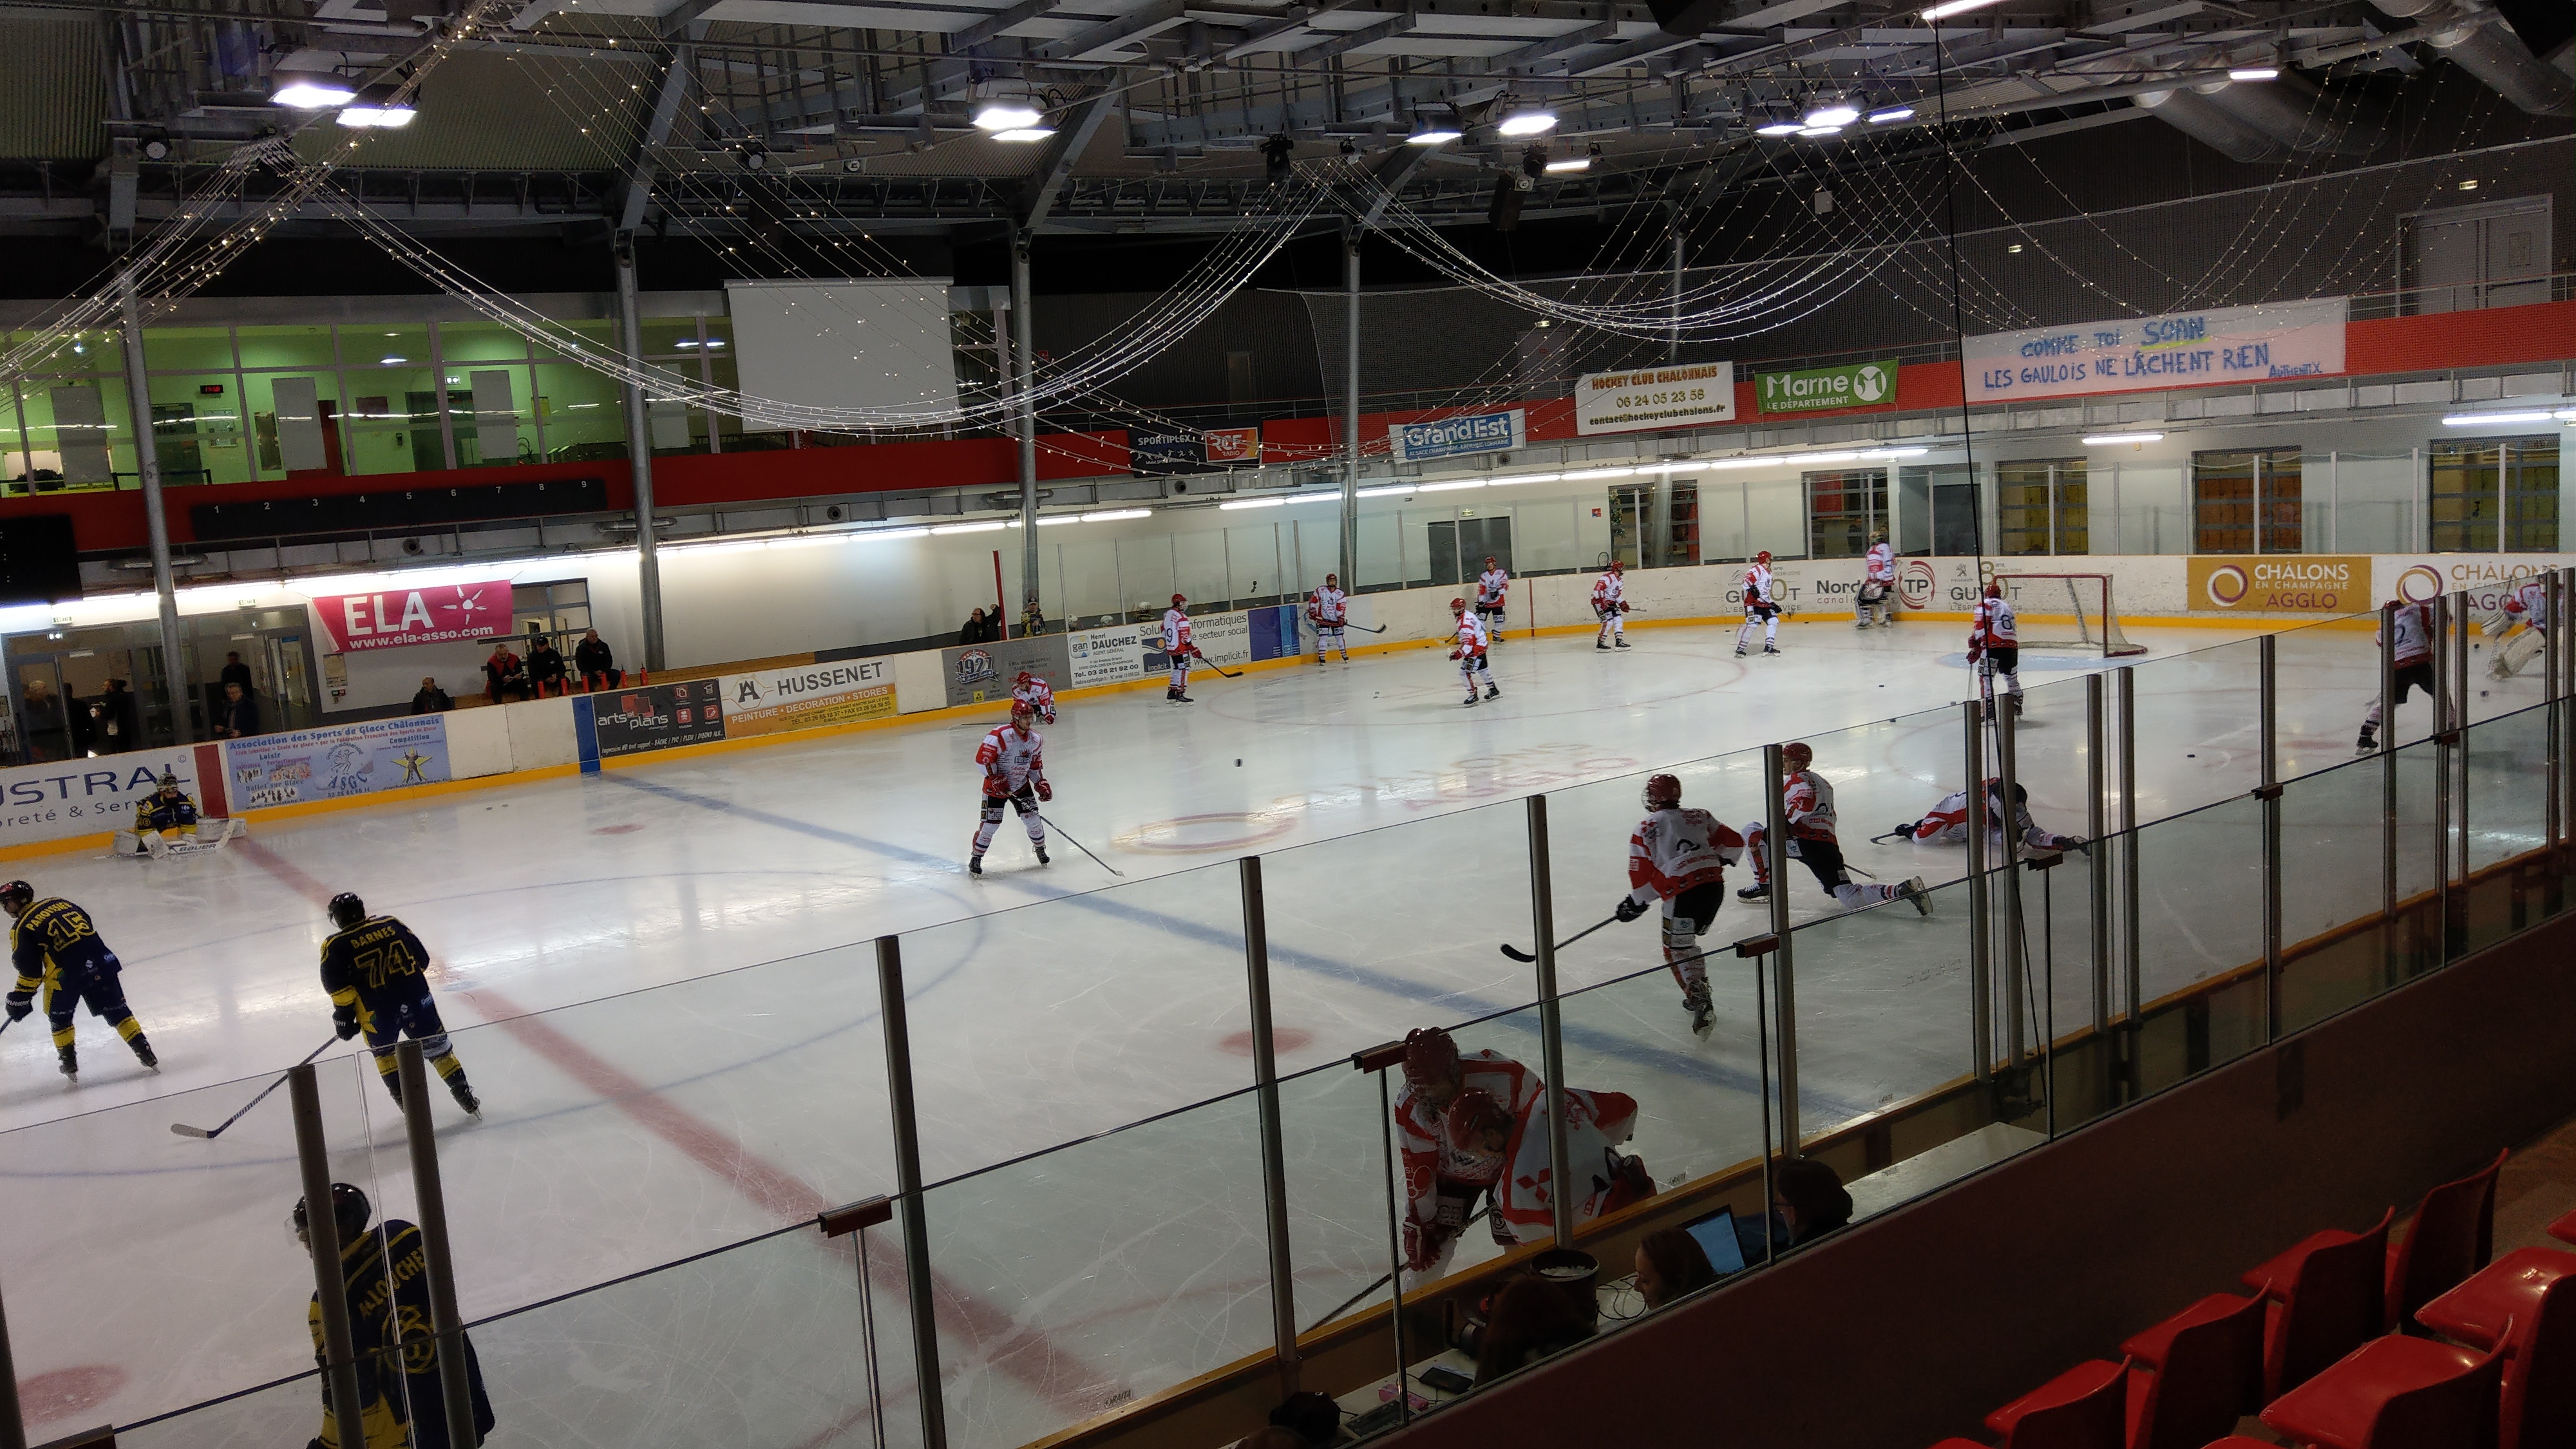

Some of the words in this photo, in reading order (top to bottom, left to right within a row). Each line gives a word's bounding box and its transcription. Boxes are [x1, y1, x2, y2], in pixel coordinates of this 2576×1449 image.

[2021, 334, 2078, 358] COMME
[2141, 316, 2204, 346] SOAN
[1984, 368, 2012, 389] LES
[2096, 358, 2117, 377] NE
[2125, 346, 2214, 377] LÂCHENT
[1591, 375, 1629, 390] HOCKEY
[1631, 372, 1655, 386] CLUB
[1766, 374, 1849, 399] Marne
[1616, 396, 1631, 408] 06
[1634, 394, 1649, 407] 24
[1653, 392, 1667, 405] 05
[1671, 390, 1687, 403] 23
[1689, 388, 1705, 401] 58
[1780, 395, 1849, 410] DÉPARTEMENT
[1138, 434, 1191, 446] SPORTIPLEX
[2255, 561, 2349, 580] CHÂLONS
[1904, 580, 1929, 593] TP
[2255, 581, 2269, 589] EN
[2275, 581, 2349, 589] CHAMPAGNE
[2266, 592, 2337, 609] AGGLO
[343, 591, 434, 636] ELA
[349, 625, 494, 650] www.ela-asso.com
[1091, 636, 1137, 650] DAUCHEZ
[1198, 631, 1226, 641] secteur
[1227, 625, 1247, 636] social
[1072, 642, 1088, 652] gan
[956, 656, 992, 676] 1927
[777, 661, 882, 696] HUSSENET
[732, 708, 779, 724] PEINTURE
[786, 696, 845, 714] DECORATION
[853, 687, 887, 701] STORES
[598, 712, 627, 726] arts
[630, 714, 668, 730] plans
[229, 735, 288, 750] Association
[290, 734, 307, 742] des
[310, 730, 342, 741] Sports
[345, 727, 355, 735] de
[359, 723, 384, 735] Glace
[388, 716, 439, 730] Châlonnais
[259, 752, 281, 761] Loisir
[327, 771, 368, 791] ASGC
[179, 842, 217, 852] BAUER
[48, 911, 96, 952] 15
[350, 925, 397, 949] BARNES
[354, 939, 417, 990] 74
